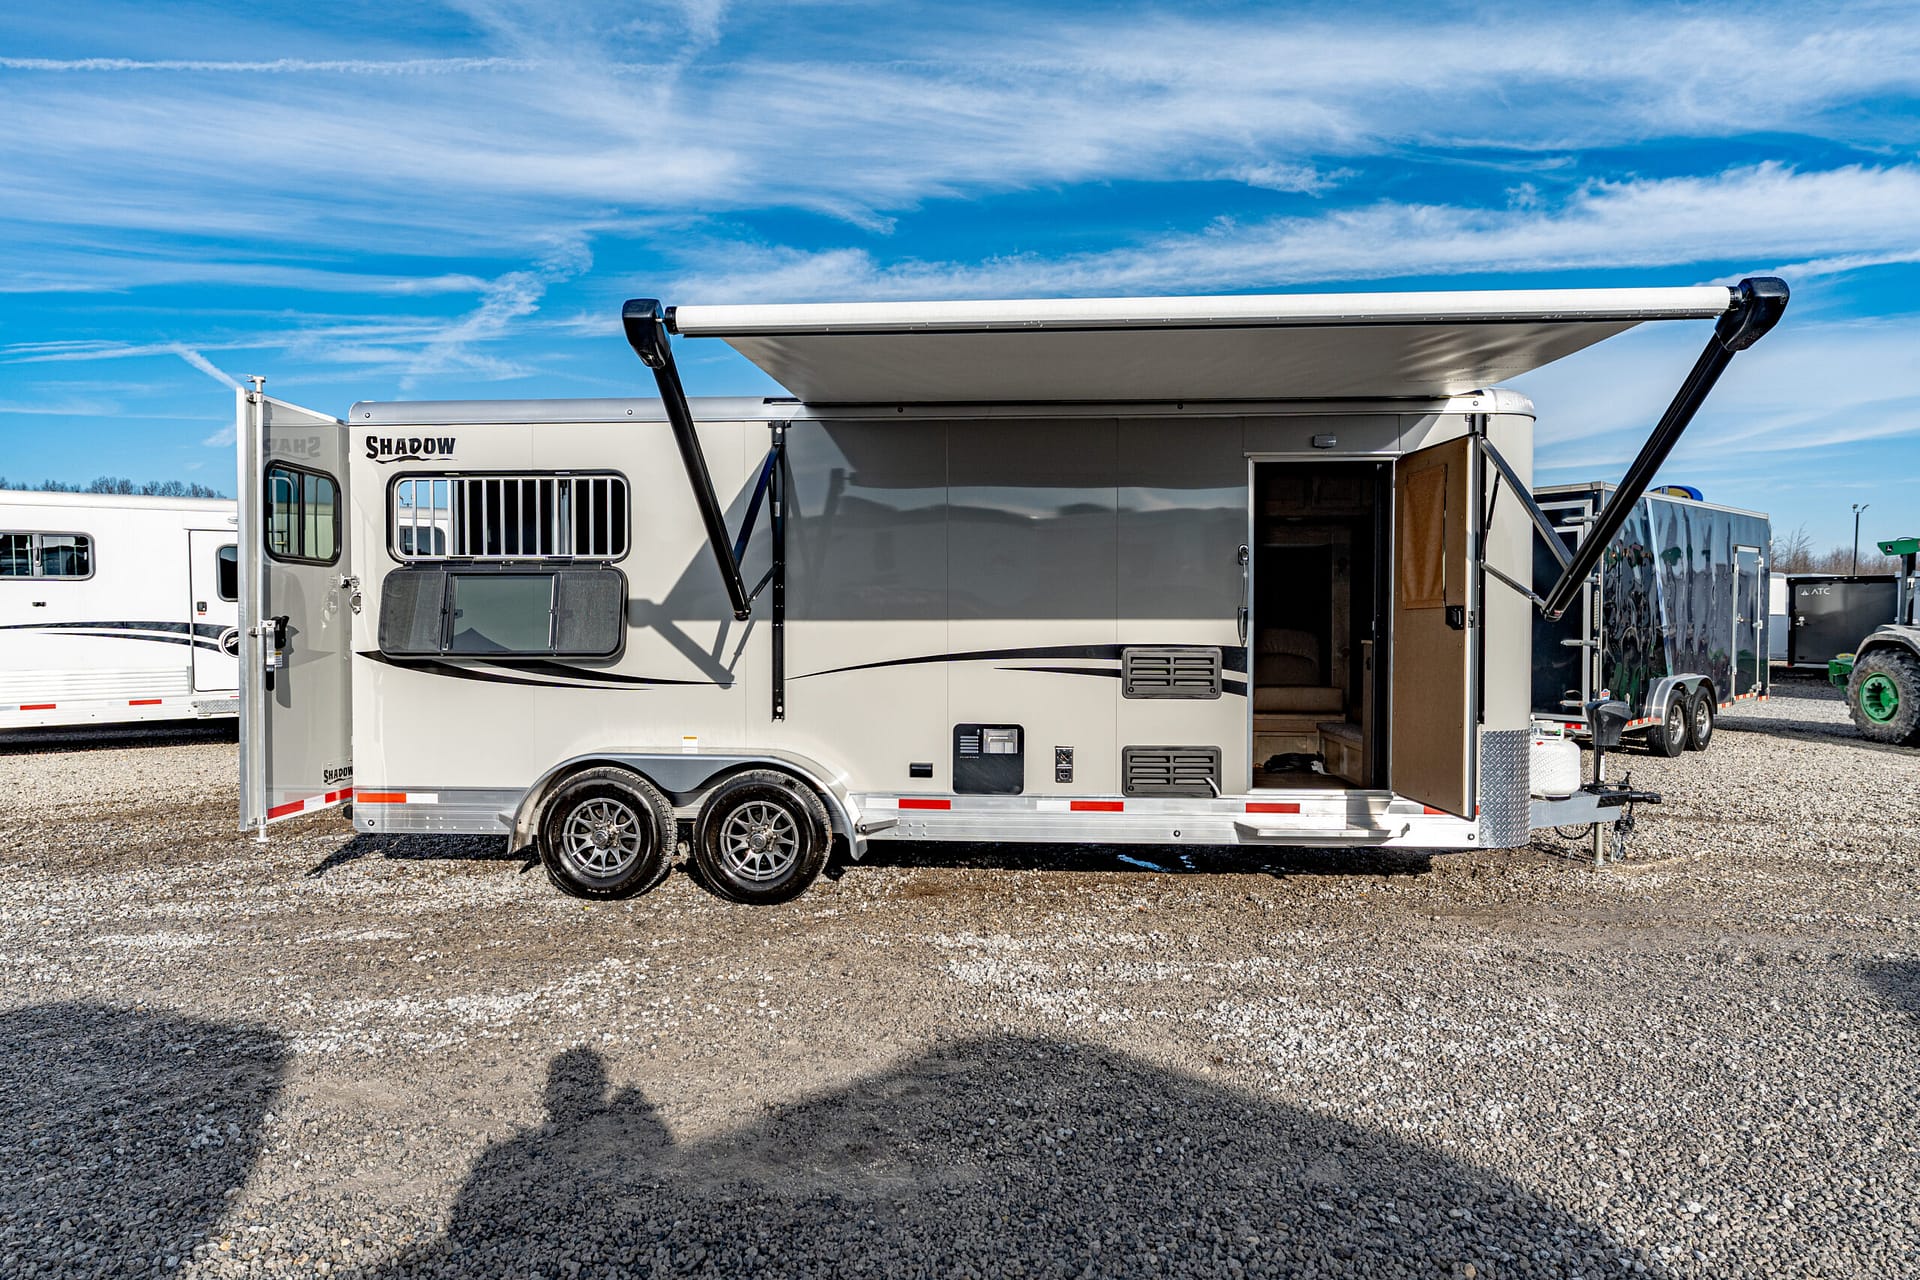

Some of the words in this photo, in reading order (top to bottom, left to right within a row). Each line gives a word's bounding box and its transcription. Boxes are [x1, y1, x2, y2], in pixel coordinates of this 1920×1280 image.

[365, 435, 456, 460] SHADOW
[1811, 587, 1831, 595] ATC
[323, 765, 353, 783] SHADOW
